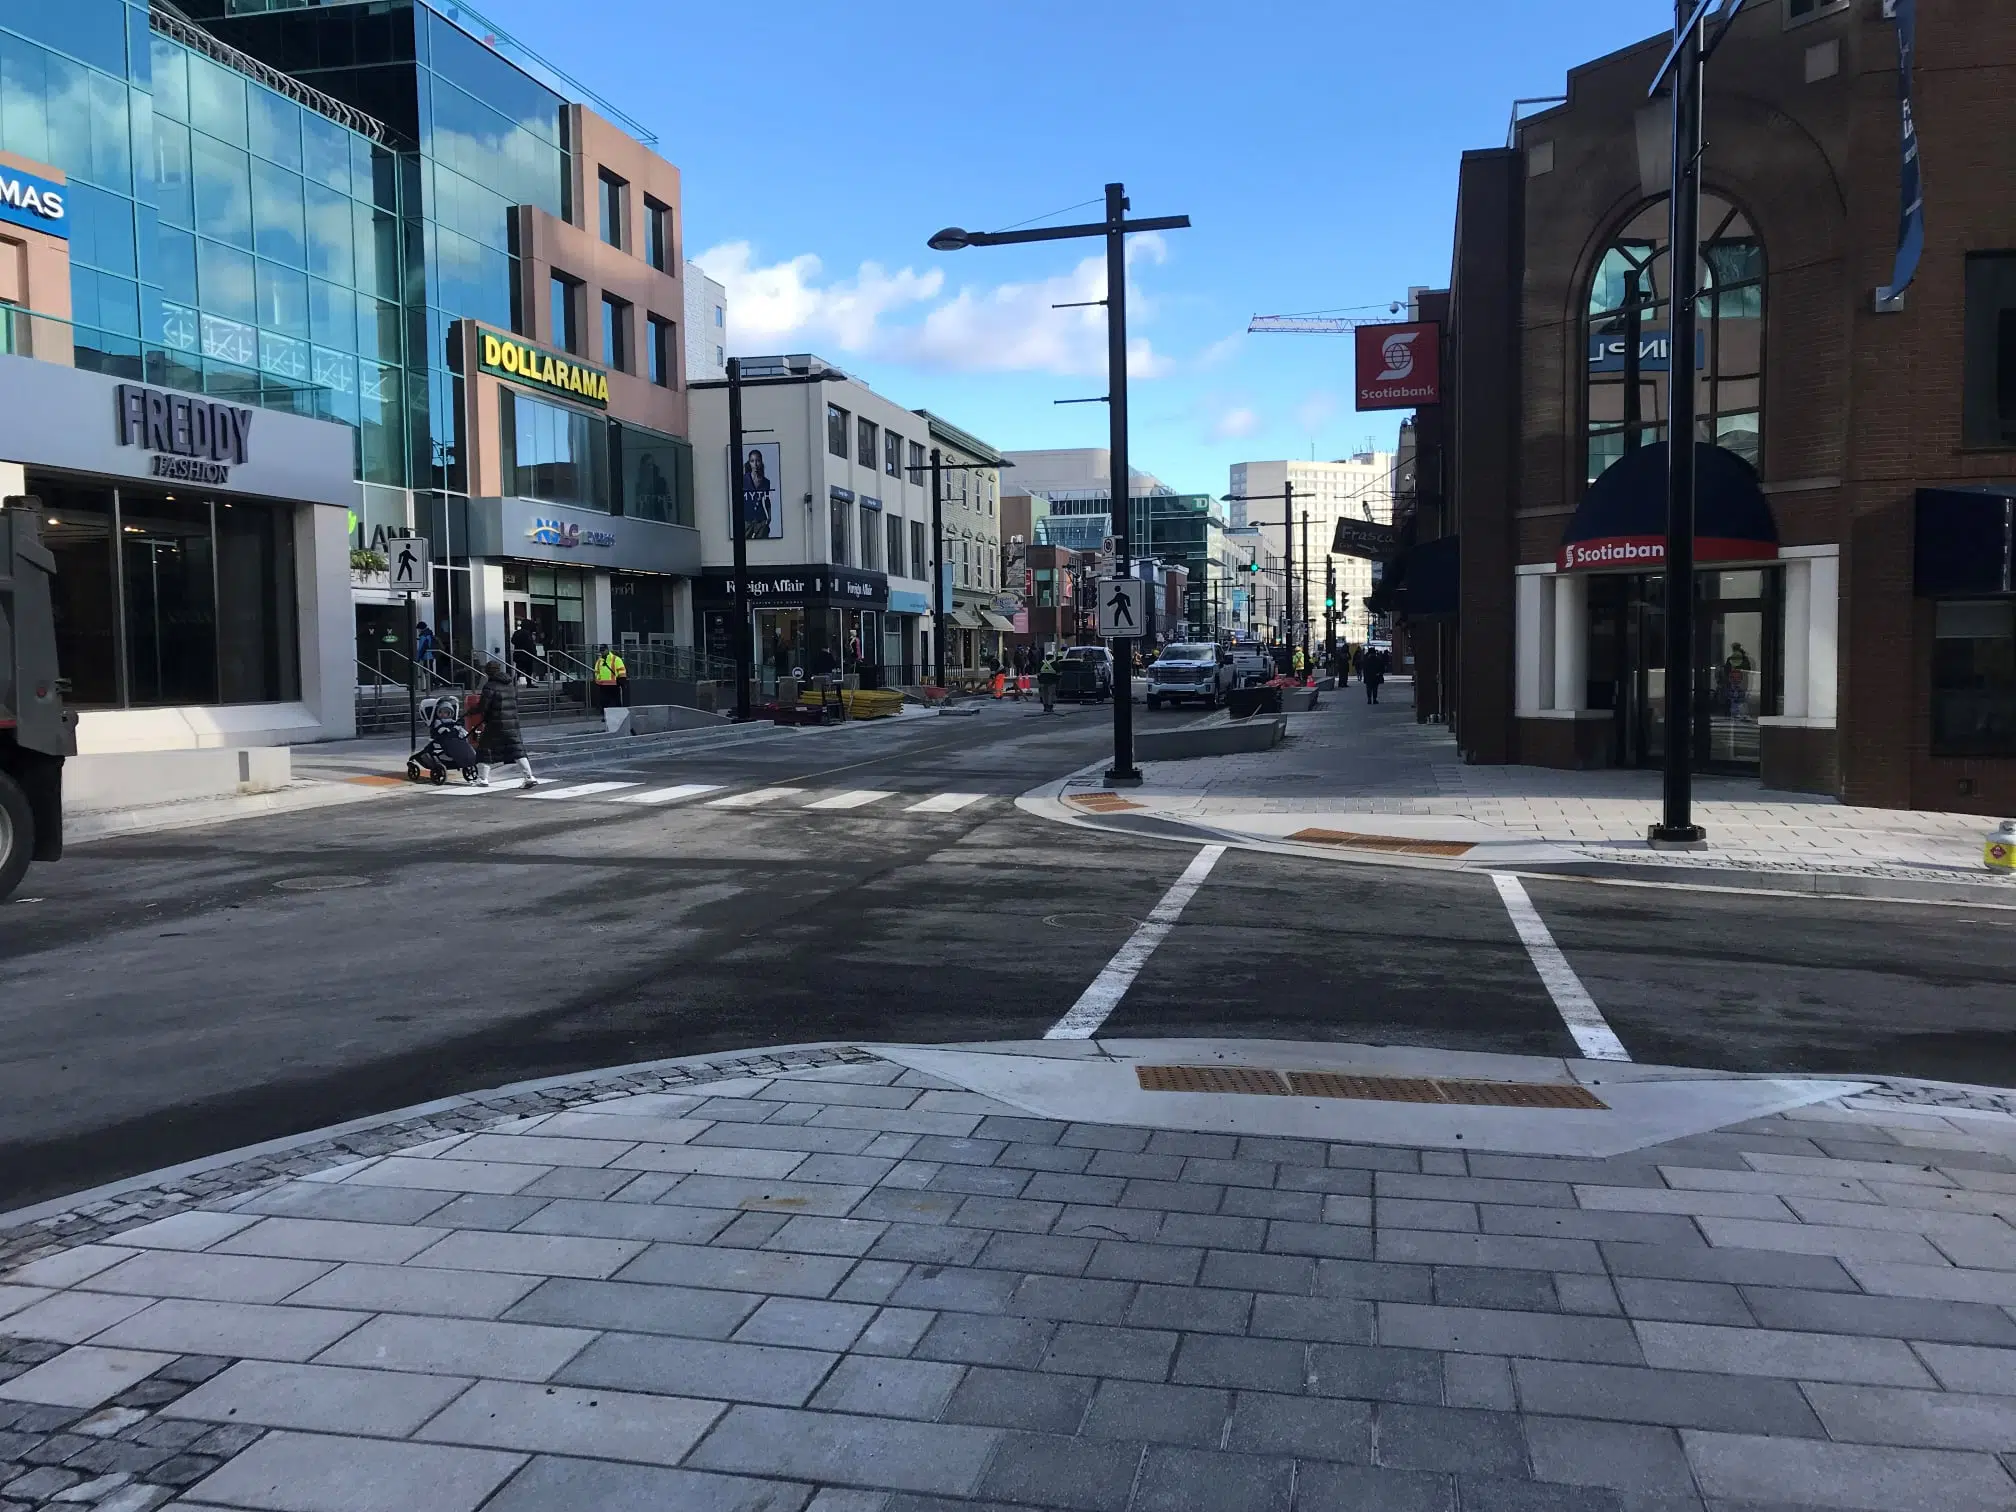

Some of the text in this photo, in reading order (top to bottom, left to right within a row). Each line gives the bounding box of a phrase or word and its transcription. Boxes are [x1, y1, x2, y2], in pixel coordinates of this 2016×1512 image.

[0, 176, 65, 219] MAS
[485, 335, 609, 402] DOLLARAMA
[1361, 385, 1434, 399] Scotiabank
[114, 385, 252, 464] FREDDY
[152, 455, 230, 483] FASHION
[1192, 497, 1208, 508] TD
[1342, 525, 1396, 543] Frasca
[1577, 541, 1664, 562] Scotiaban
[725, 579, 804, 597] Foeign Affair
